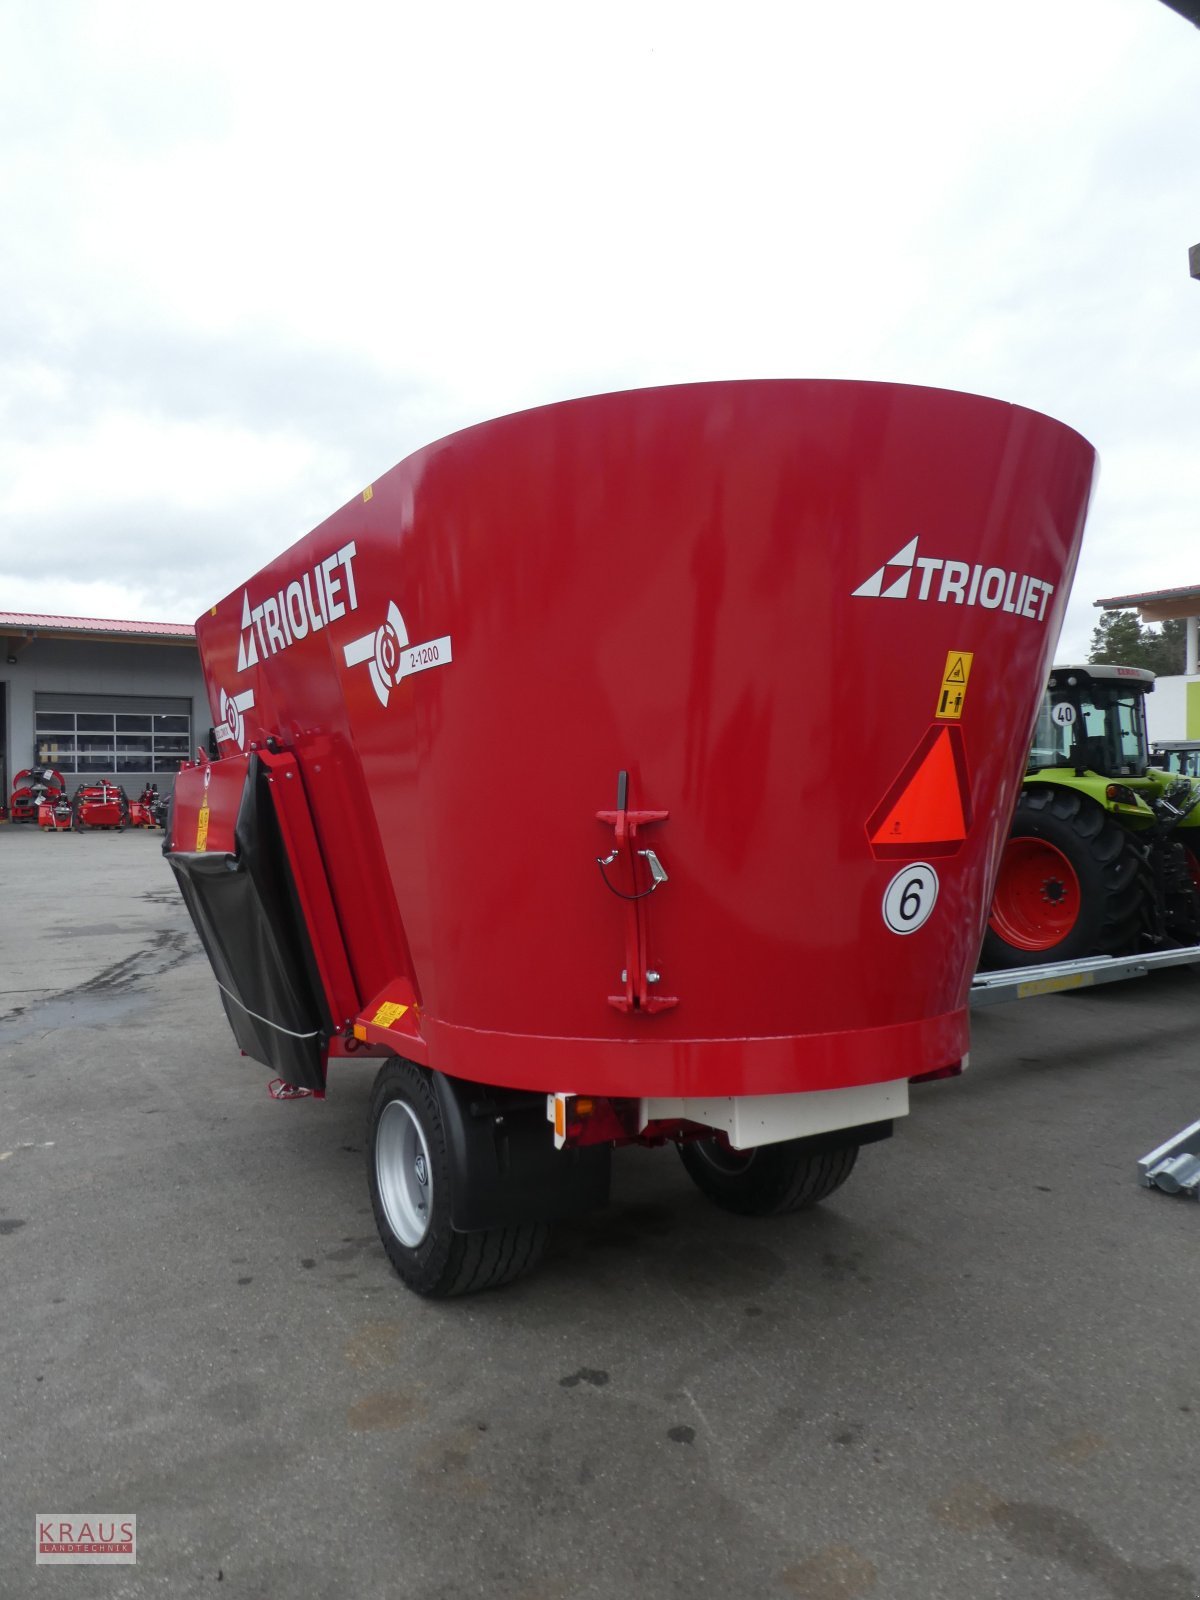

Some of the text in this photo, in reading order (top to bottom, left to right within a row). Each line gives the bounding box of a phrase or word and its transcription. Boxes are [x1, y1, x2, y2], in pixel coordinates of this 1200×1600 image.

[250, 540, 358, 659] TRIOLIET
[916, 557, 1054, 622] TRIOLIET
[410, 645, 440, 668] 2-1200
[1057, 707, 1073, 722] 40
[900, 878, 924, 921] 6
